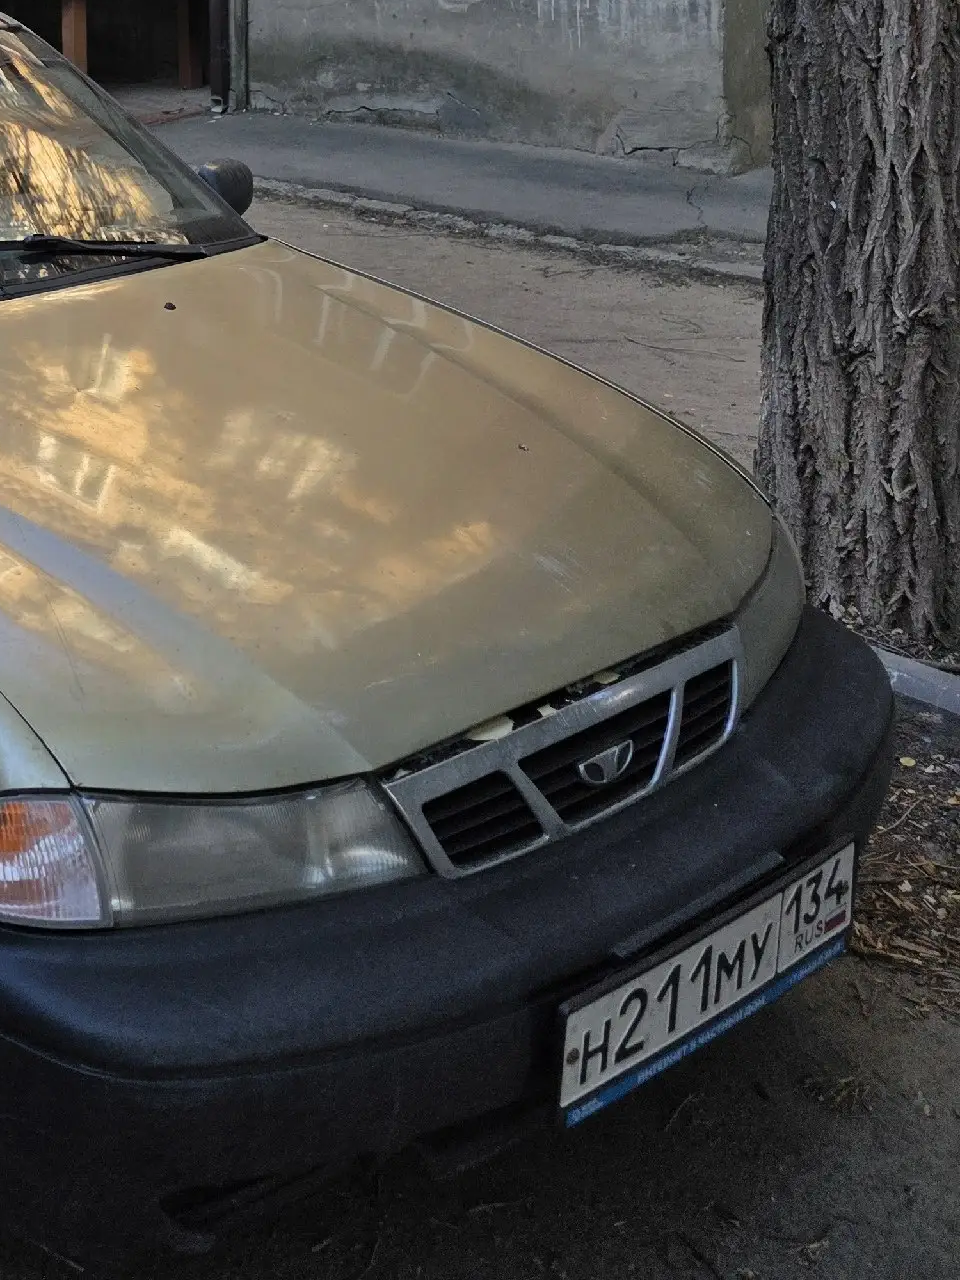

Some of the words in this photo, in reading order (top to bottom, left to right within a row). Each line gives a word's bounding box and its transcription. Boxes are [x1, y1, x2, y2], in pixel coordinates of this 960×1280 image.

[579, 922, 773, 1086] Н211МУ
[784, 857, 842, 935] 134
[794, 919, 824, 954] RUS
